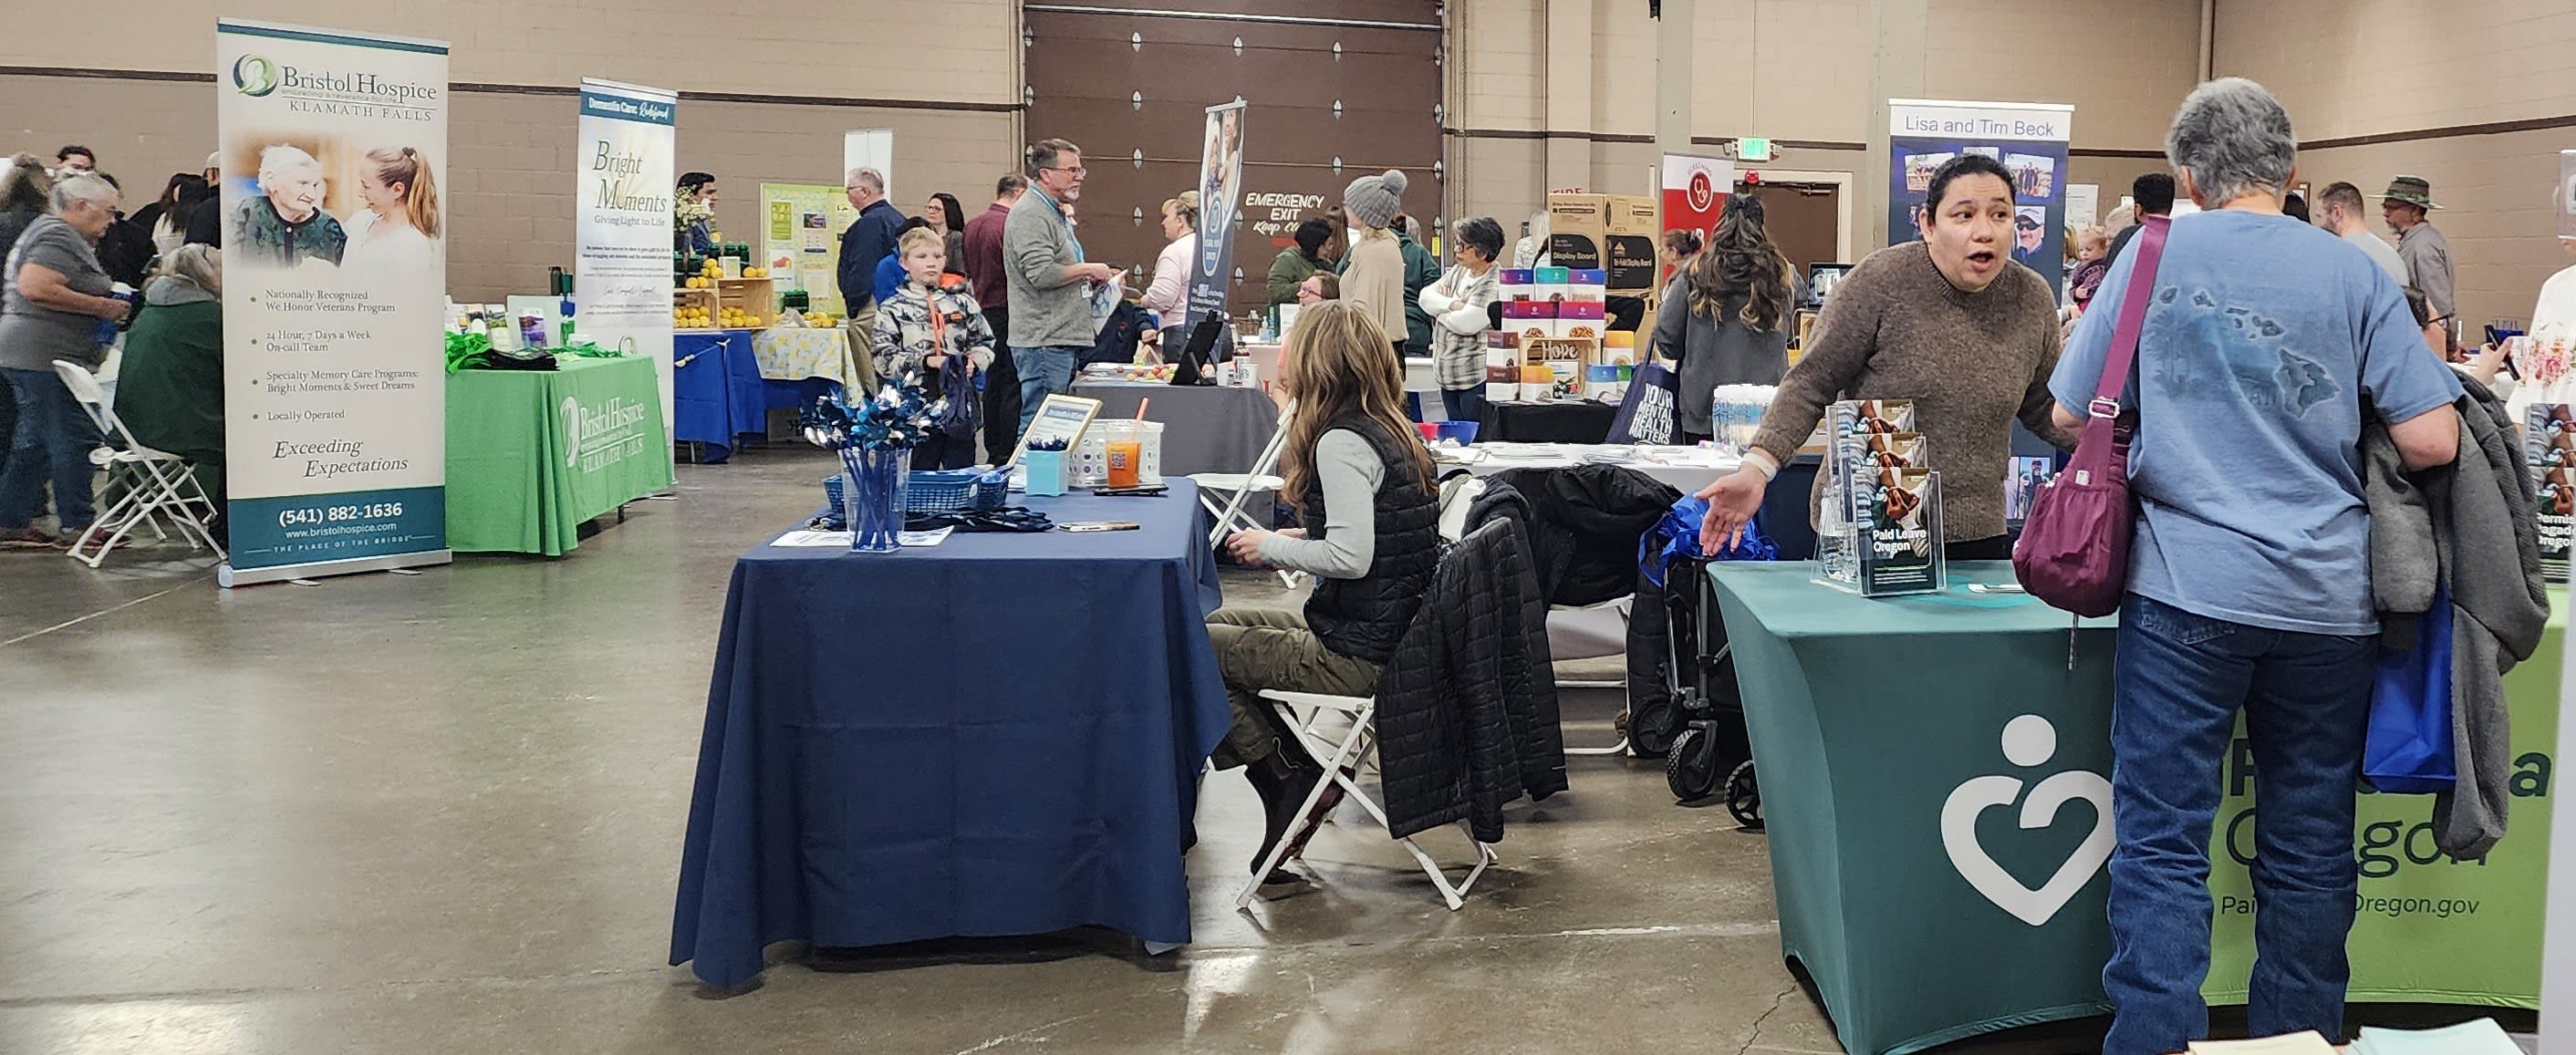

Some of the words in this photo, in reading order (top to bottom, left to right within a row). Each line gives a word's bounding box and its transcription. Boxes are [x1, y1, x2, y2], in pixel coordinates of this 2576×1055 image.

[282, 66, 350, 91] Bristol
[356, 73, 437, 103] Hospice
[289, 100, 373, 118] KLAMATH
[382, 108, 432, 121] FALLS
[1906, 116, 1938, 131] Lisa
[1944, 119, 1974, 133] and
[1979, 119, 2008, 135] Tim
[2014, 120, 2054, 137] Beck
[592, 140, 643, 178] Bright
[595, 179, 668, 212] Moments
[1245, 192, 1324, 209] EMERGENCY
[594, 214, 619, 226] Giving
[620, 216, 639, 226] Light
[642, 218, 649, 226] to
[651, 218, 665, 226] Life
[1271, 208, 1302, 221] EXIT
[1553, 252, 1576, 261] Display
[1576, 252, 1596, 261] Board
[265, 290, 314, 301] Nationally
[317, 290, 369, 302] Recognized
[265, 303, 280, 311] We
[284, 303, 314, 312] Honor
[317, 303, 355, 312] Veterans
[358, 303, 395, 315] Program
[266, 332, 275, 340] 24
[315, 330, 337, 340] Days
[347, 330, 371, 339] Week
[266, 343, 299, 352] On-call
[303, 343, 328, 351] Team
[1542, 341, 1578, 360] Hope
[266, 370, 308, 382] Specialty
[311, 370, 349, 380] Memory
[351, 369, 372, 378] Care
[267, 383, 296, 395] Bright
[299, 383, 341, 391] Moments
[344, 383, 350, 391] &
[353, 381, 379, 391] Sweet
[381, 381, 415, 390] Dreams
[1644, 383, 1674, 410] YOUR
[268, 411, 301, 422] Locally
[304, 409, 345, 421] Operated
[1636, 401, 1672, 420] MENTAL
[1632, 414, 1673, 434] HEALTH
[1628, 427, 1670, 444] MATTERS
[274, 439, 364, 459] Exceeding
[304, 457, 409, 479] Expectations
[278, 508, 323, 528] (541)
[327, 502, 403, 522] 882-1636
[286, 522, 397, 539] www.bristolhospice.com
[1872, 529, 1894, 540] Paid
[1896, 529, 1927, 540] Leave
[298, 543, 329, 551] PLACE
[1873, 542, 1911, 553] Oregon
